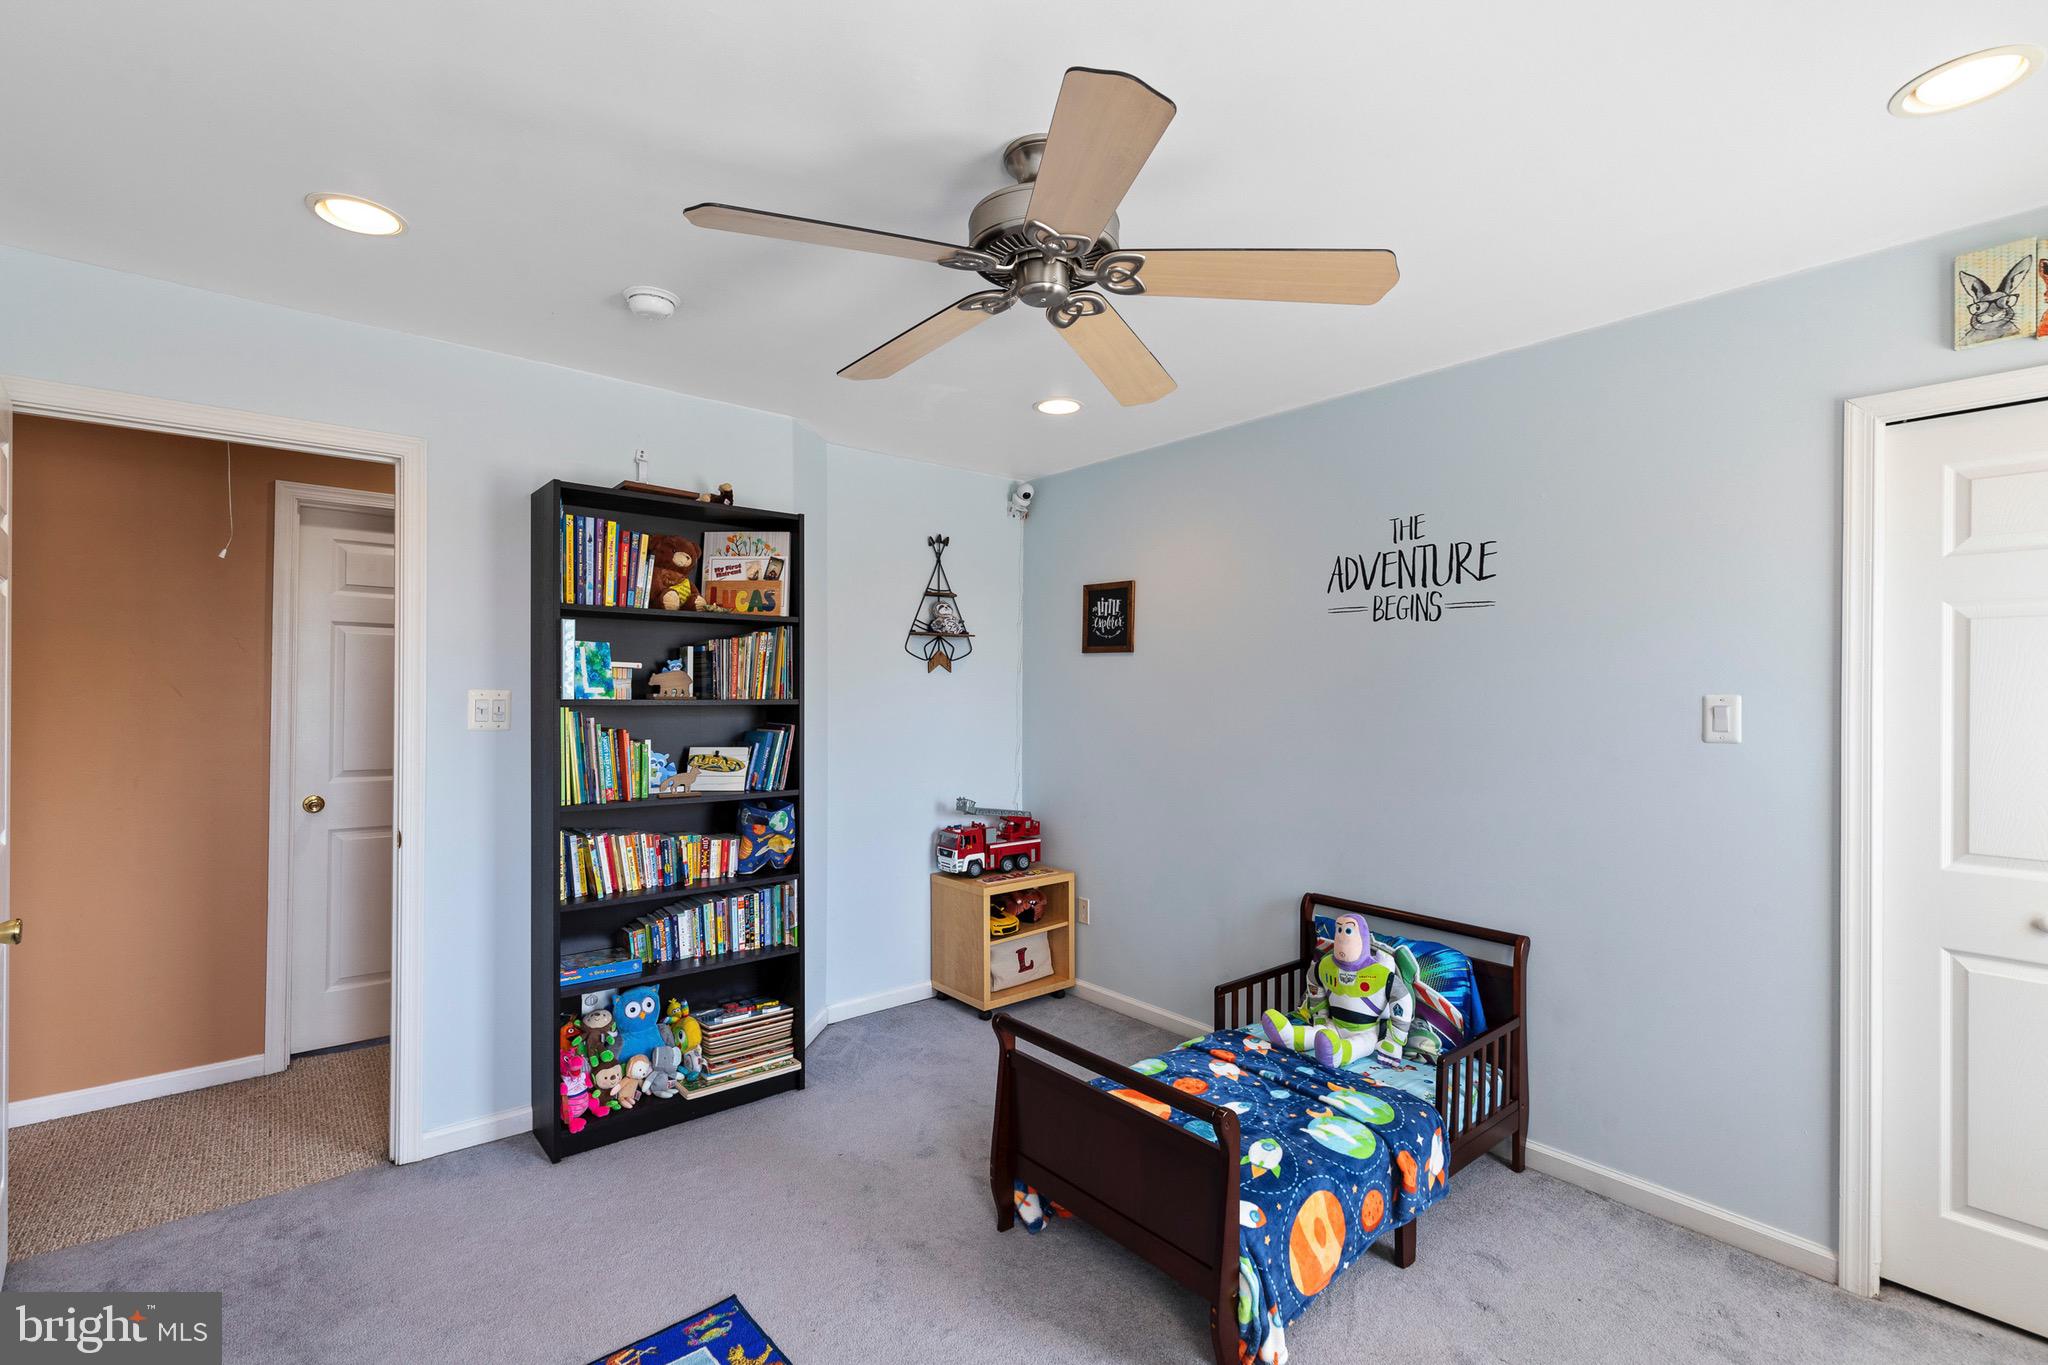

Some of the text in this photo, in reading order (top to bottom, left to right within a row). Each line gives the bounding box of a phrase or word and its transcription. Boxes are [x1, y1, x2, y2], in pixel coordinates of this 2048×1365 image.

[1389, 513, 1426, 544] THE
[1327, 540, 1498, 594] ADVENTURE
[709, 586, 776, 612] LUCAS
[1372, 590, 1443, 622] BEGINS
[1016, 947, 1034, 973] L
